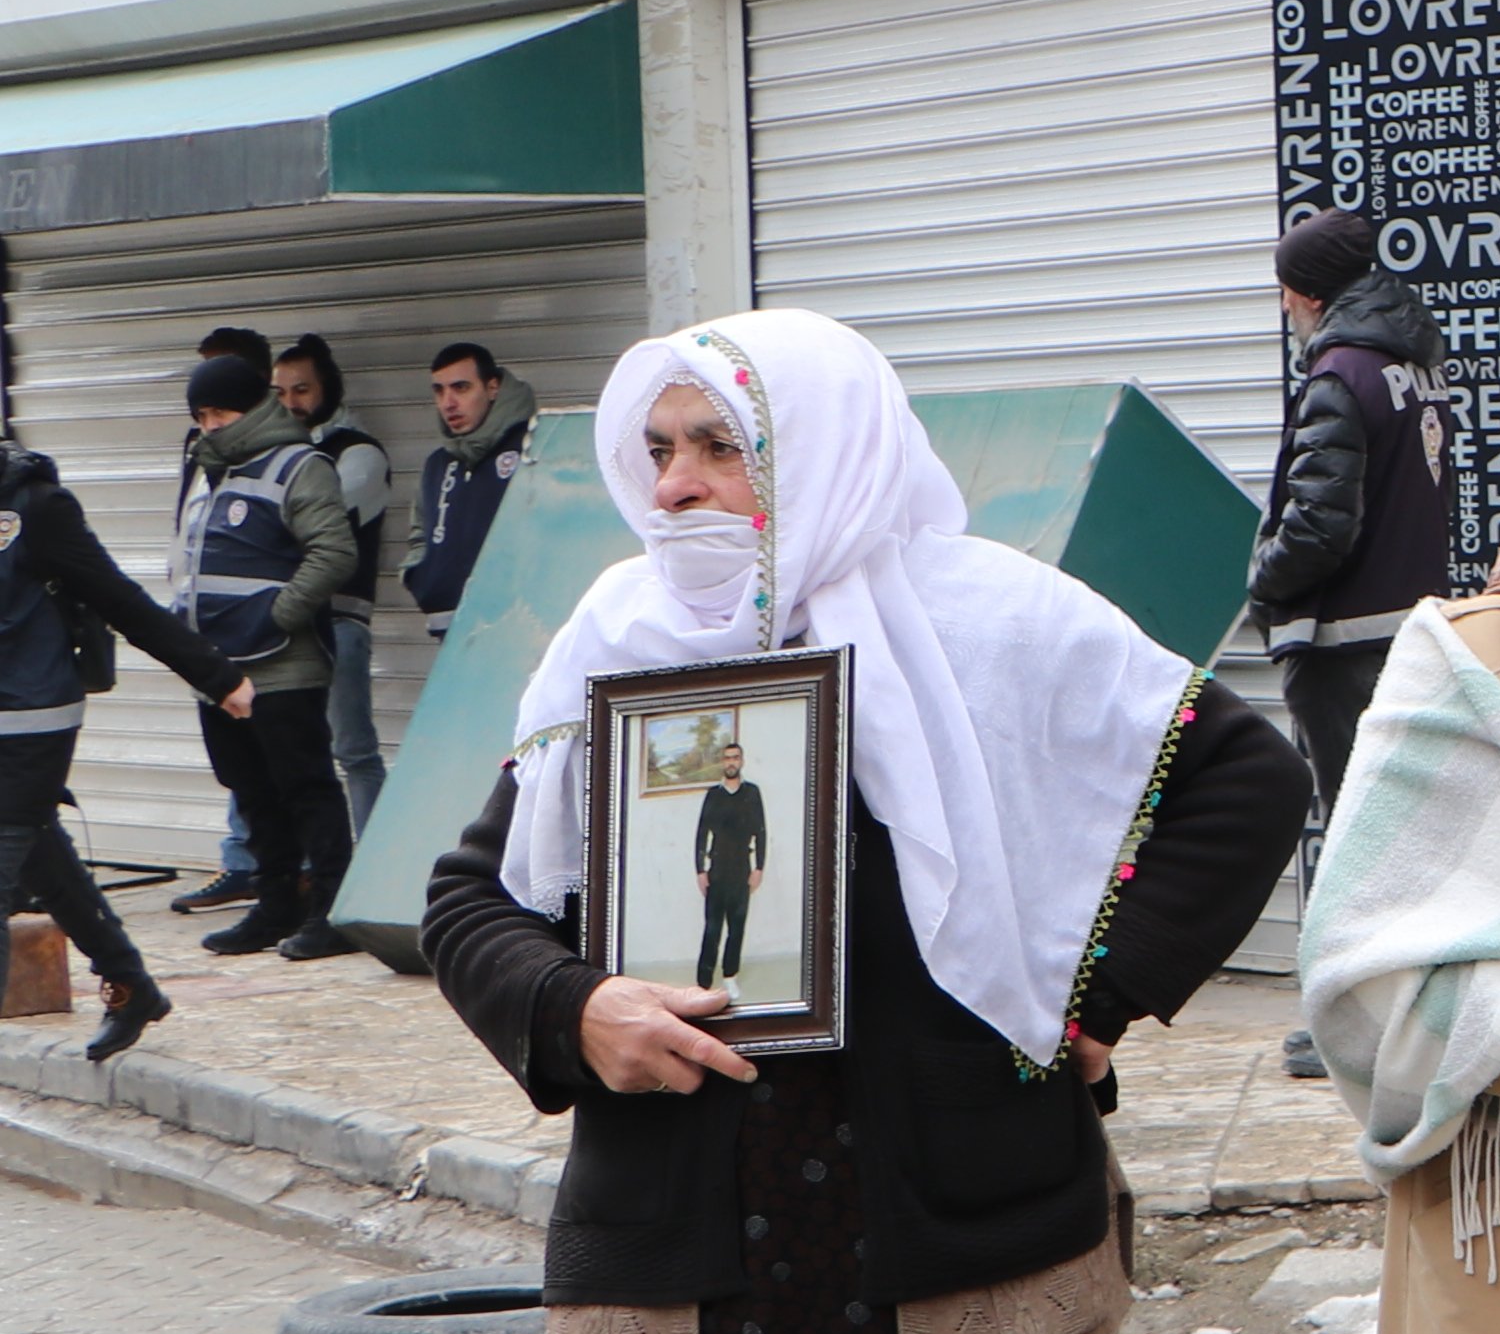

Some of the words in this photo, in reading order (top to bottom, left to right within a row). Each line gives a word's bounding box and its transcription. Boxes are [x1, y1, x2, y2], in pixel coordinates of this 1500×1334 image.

[1365, 85, 1467, 118] COFFEE
[1329, 61, 1365, 211] COFFEE
[1370, 115, 1469, 145] LOVREN
[1391, 144, 1494, 178] COFFEE
[1458, 470, 1480, 554] COFFEE
